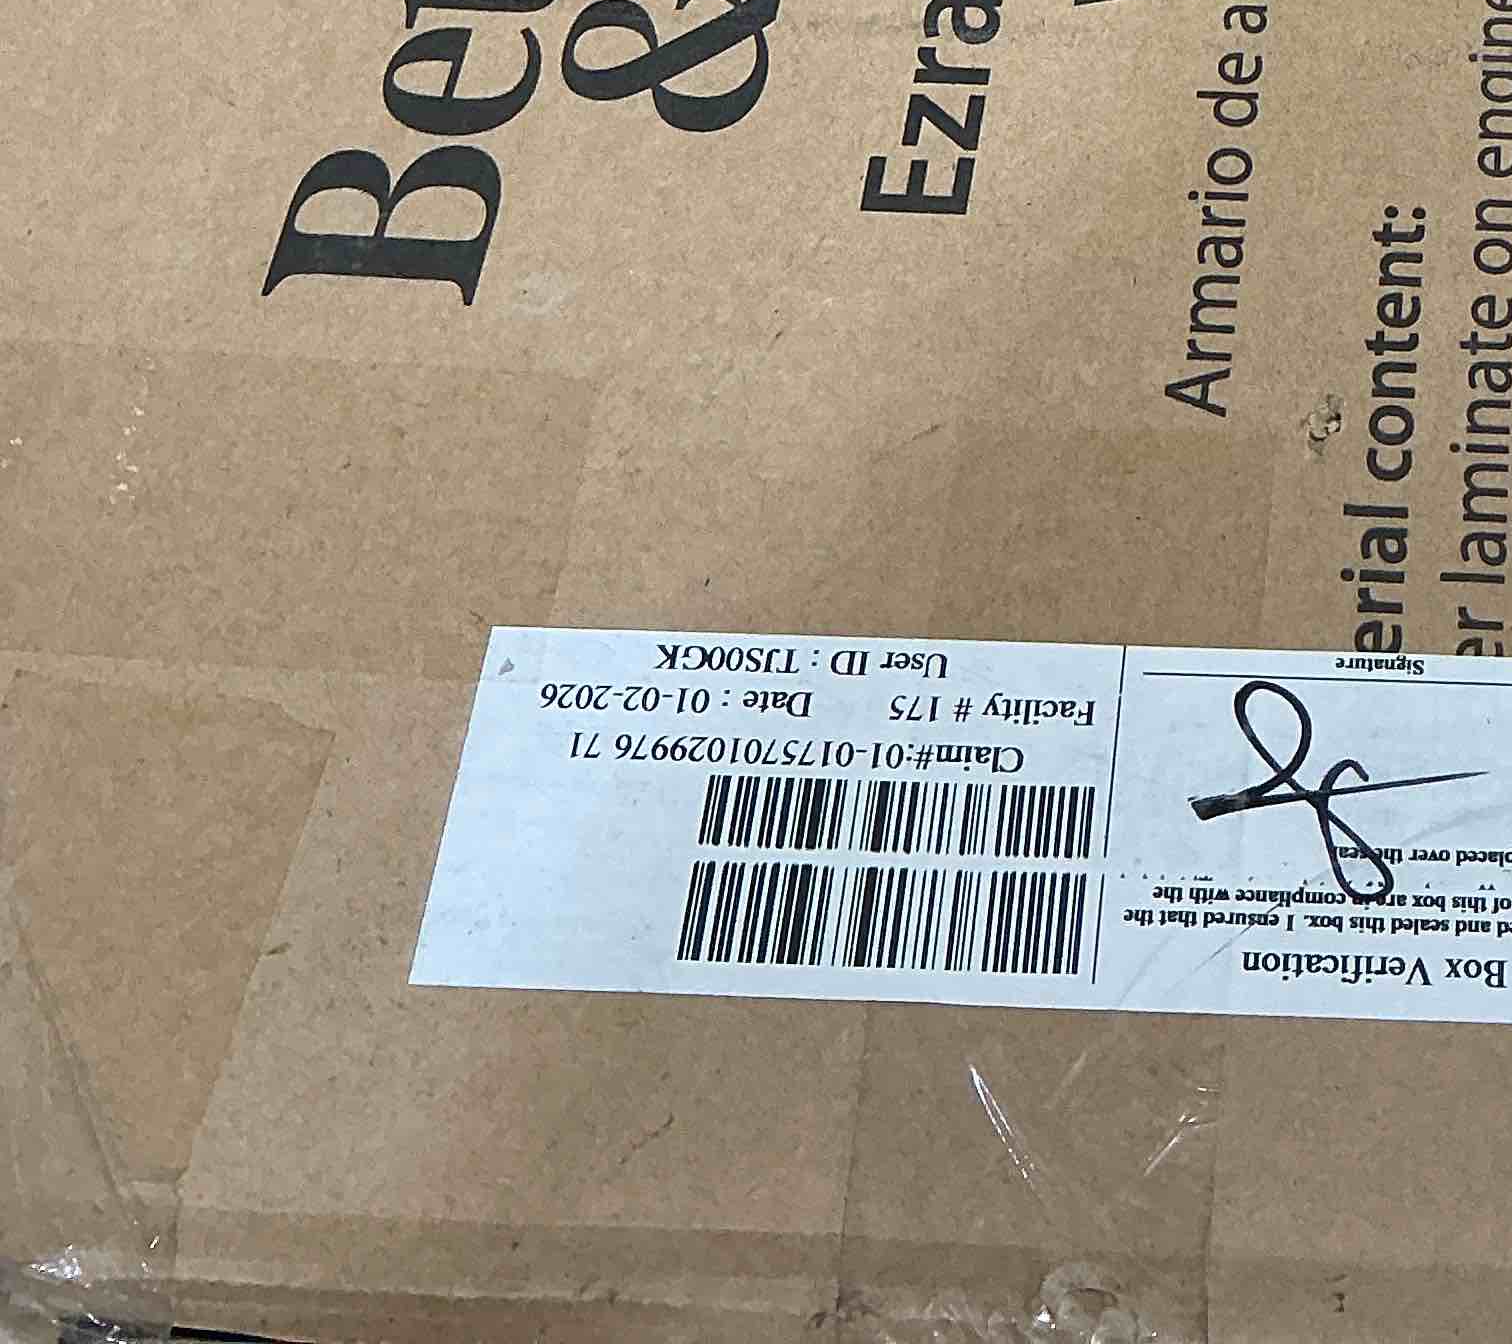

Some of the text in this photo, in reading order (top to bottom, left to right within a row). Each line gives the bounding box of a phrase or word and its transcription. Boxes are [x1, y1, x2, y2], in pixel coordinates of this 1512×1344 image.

[1197, 53, 1263, 127] de
[1164, 148, 1252, 417] Armario
[1365, 206, 1426, 481] content:
[831, 651, 870, 675] ID
[880, 652, 947, 678] User
[1335, 656, 1425, 677] Signature
[541, 684, 709, 713] 01-02-2026
[743, 691, 812, 717] Date
[889, 696, 939, 722] 175
[982, 693, 1095, 726] Facility
[571, 732, 600, 758] 71
[1409, 848, 1451, 862] over
[1153, 887, 1184, 904] the
[1189, 887, 1230, 906] with
[1235, 884, 1346, 907] compliance
[1412, 894, 1446, 912] box
[1451, 895, 1487, 913] this
[1490, 897, 1512, 914] of
[1123, 909, 1153, 926] the
[1158, 909, 1197, 927] that
[1202, 911, 1280, 930] ensured
[1287, 914, 1294, 931] I
[1304, 915, 1343, 932] box.
[1349, 916, 1385, 934] this
[1391, 917, 1450, 936] sealed
[1455, 918, 1491, 937] and
[1242, 951, 1508, 989] Box Verification
